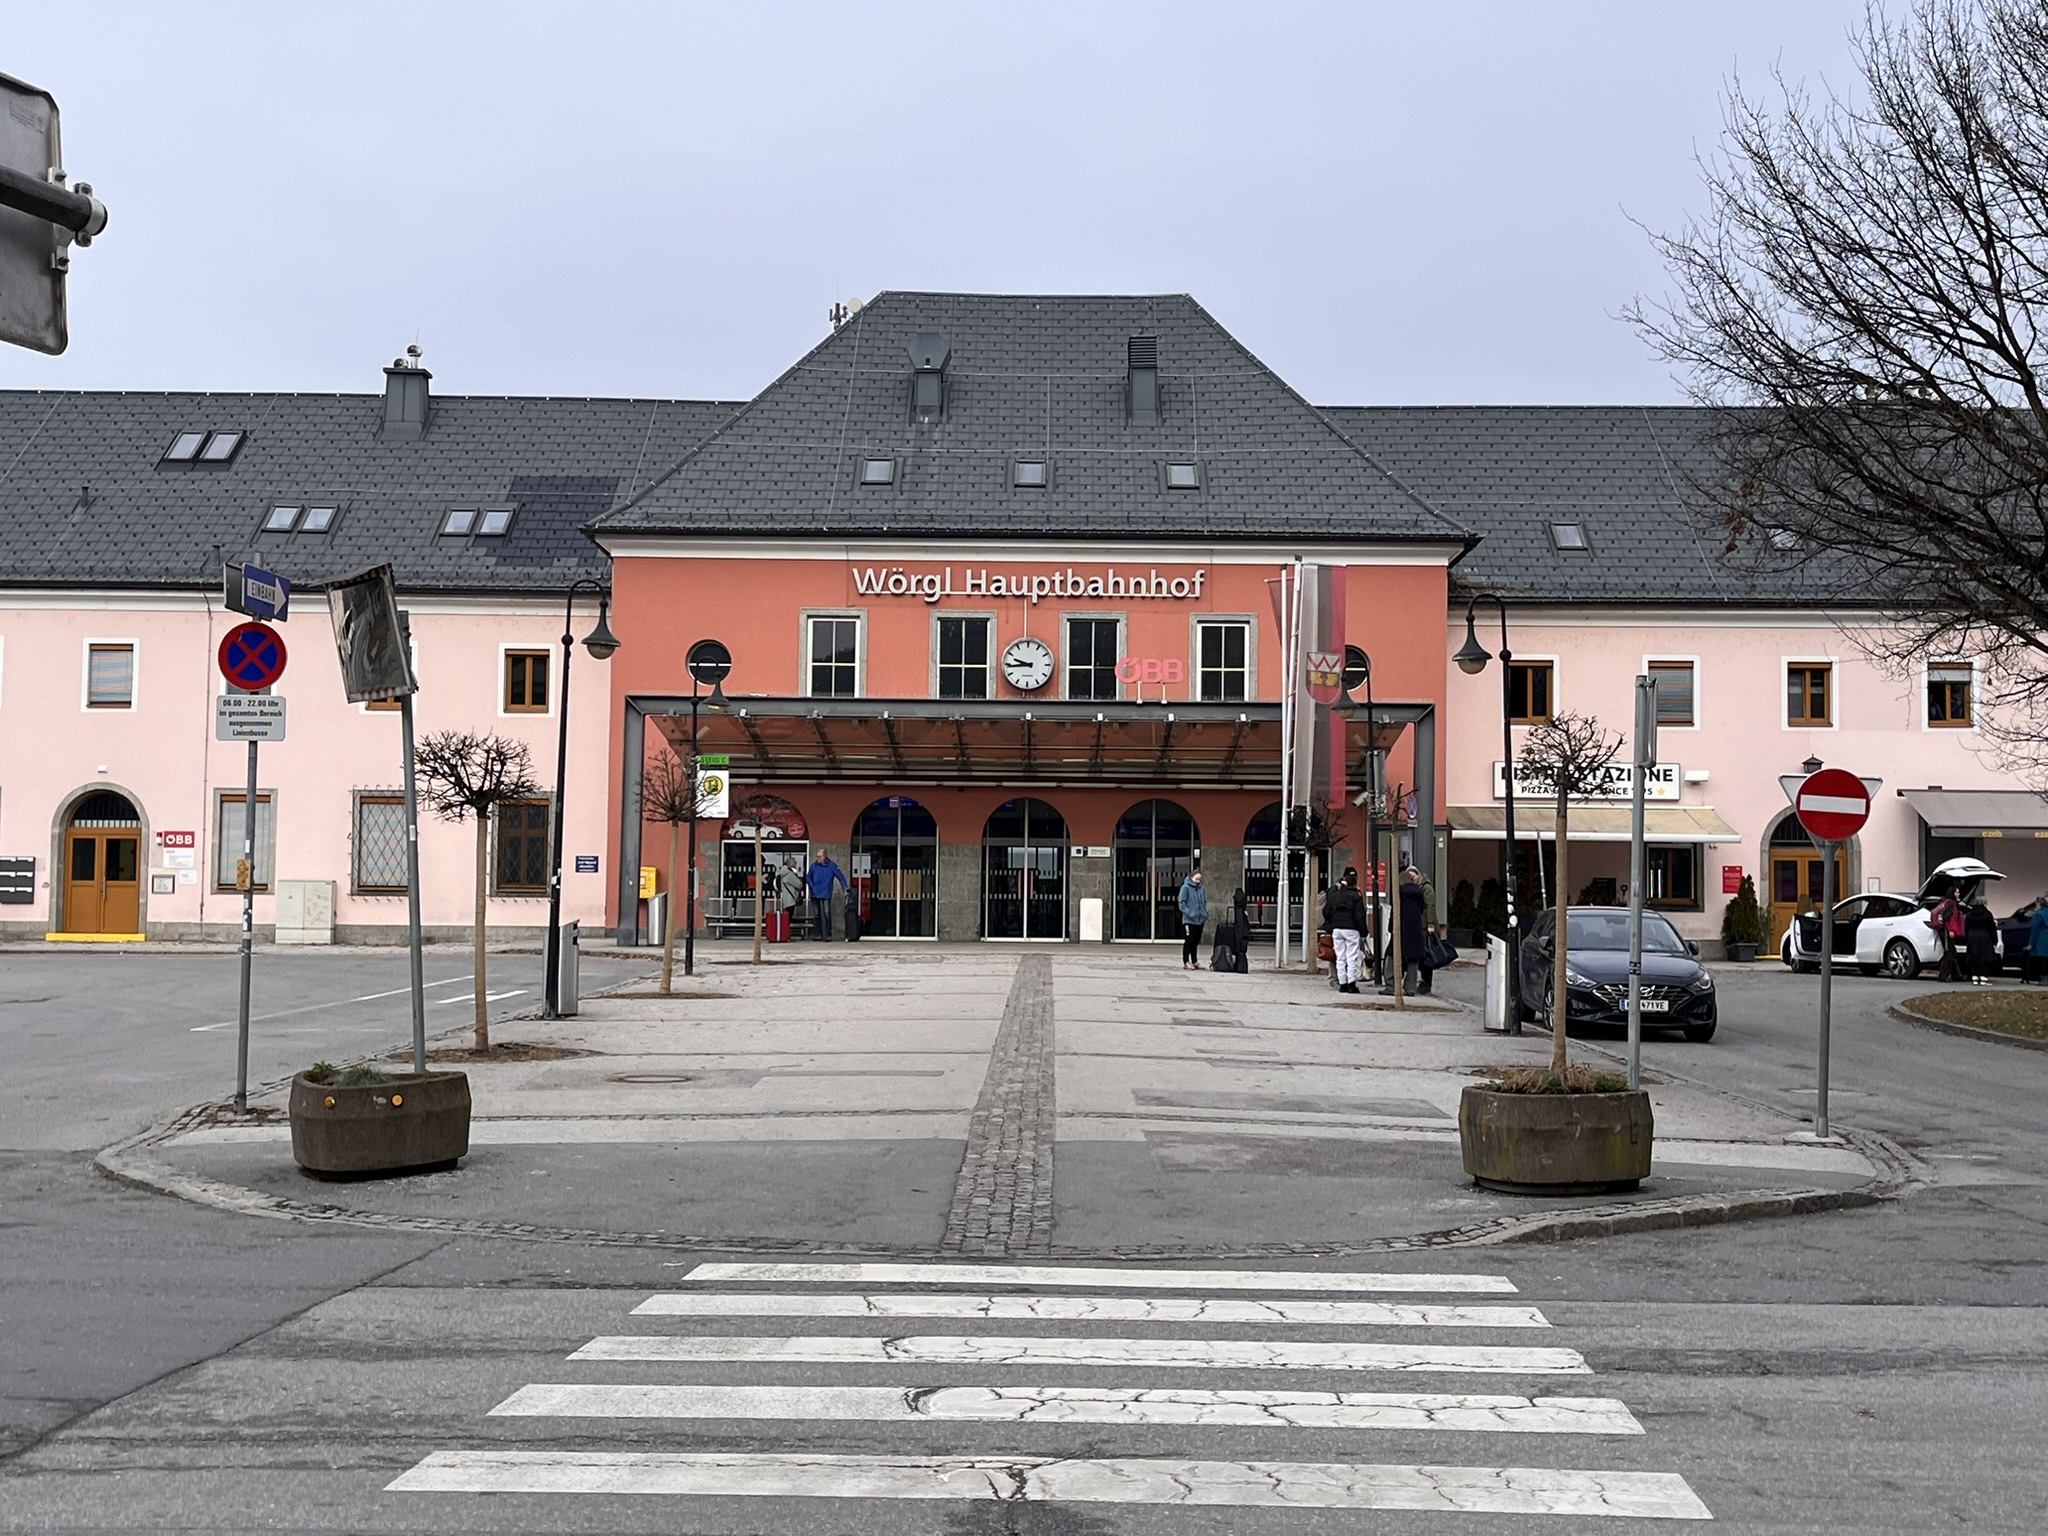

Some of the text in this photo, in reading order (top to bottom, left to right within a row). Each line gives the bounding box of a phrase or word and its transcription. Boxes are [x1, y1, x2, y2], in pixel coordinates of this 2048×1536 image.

[251, 581, 276, 604] EINBAHN
[852, 567, 1206, 605] Wörgl Hauptbahnhof
[1115, 657, 1183, 683] ÖBB
[1521, 786, 1550, 795] PIZZA
